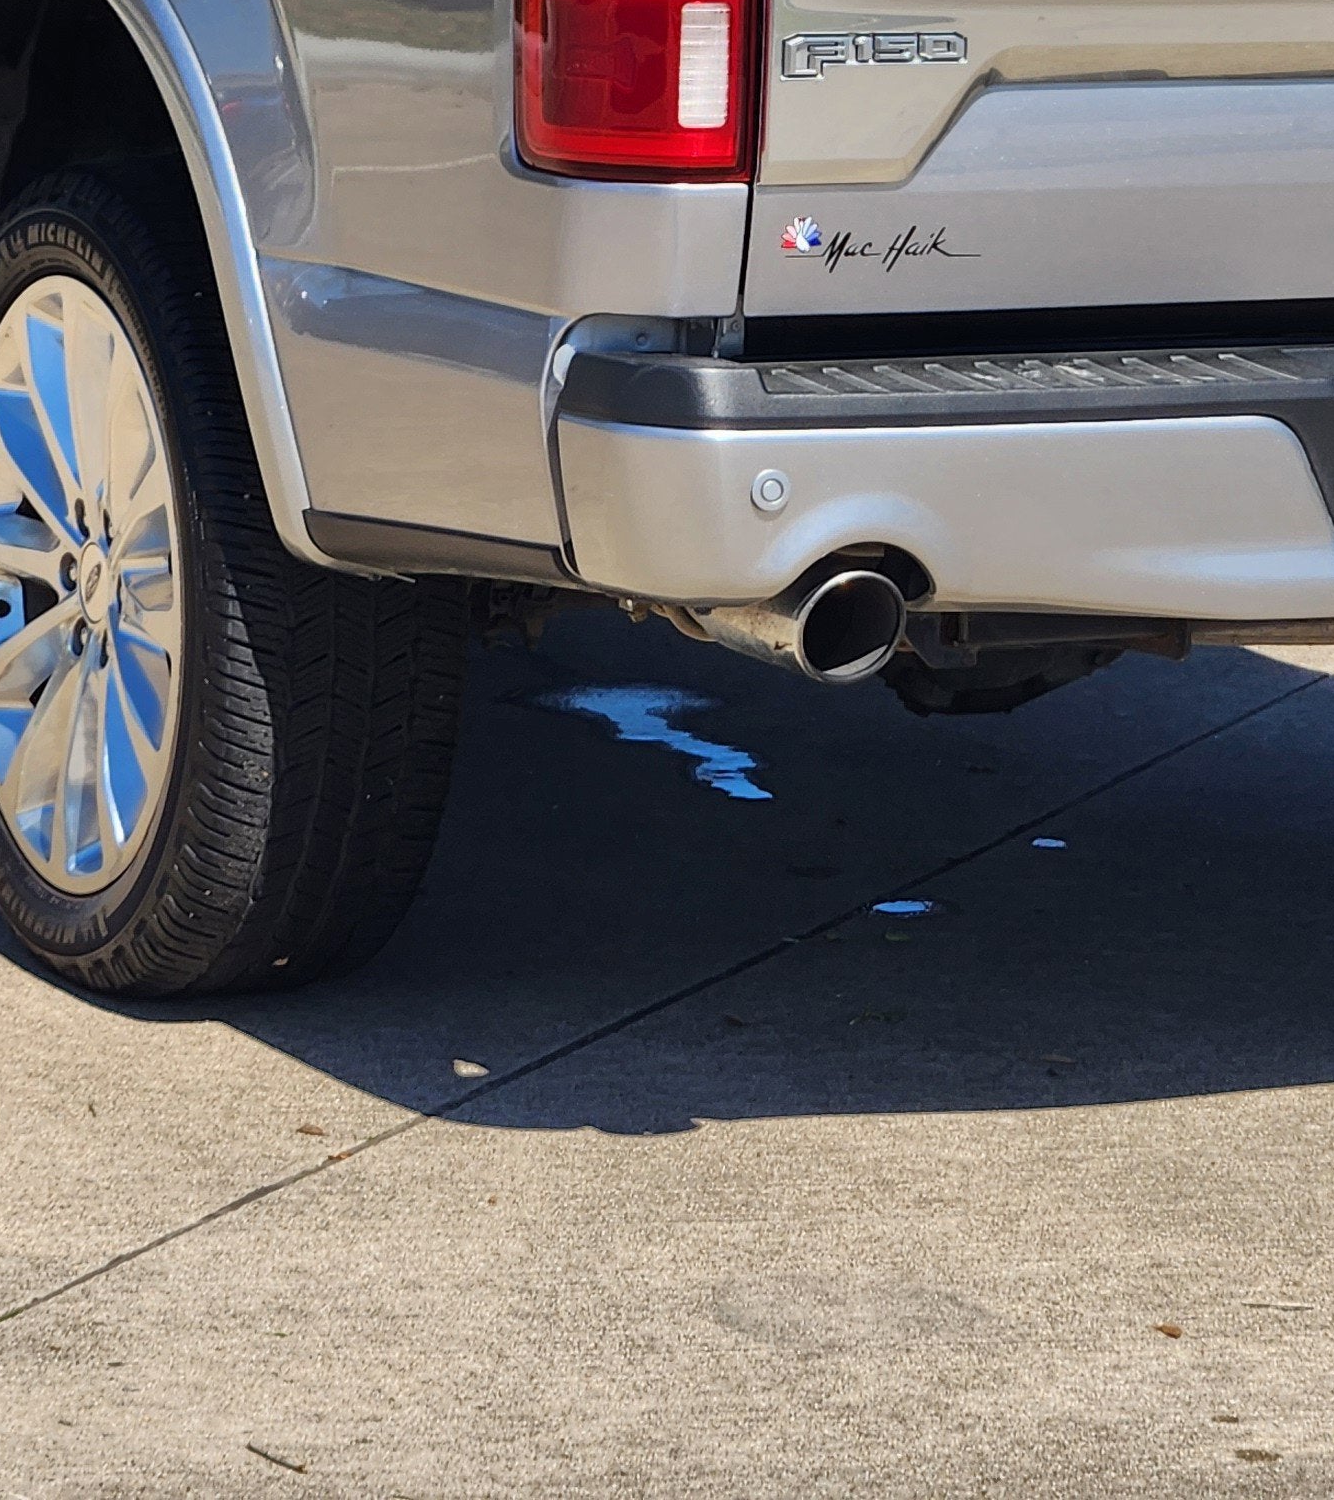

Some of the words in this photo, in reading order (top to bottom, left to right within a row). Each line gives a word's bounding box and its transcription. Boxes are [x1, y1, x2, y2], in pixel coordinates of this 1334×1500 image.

[27, 222, 104, 275] MICHELIN
[822, 231, 881, 273] Mac
[881, 225, 955, 273] Haik
